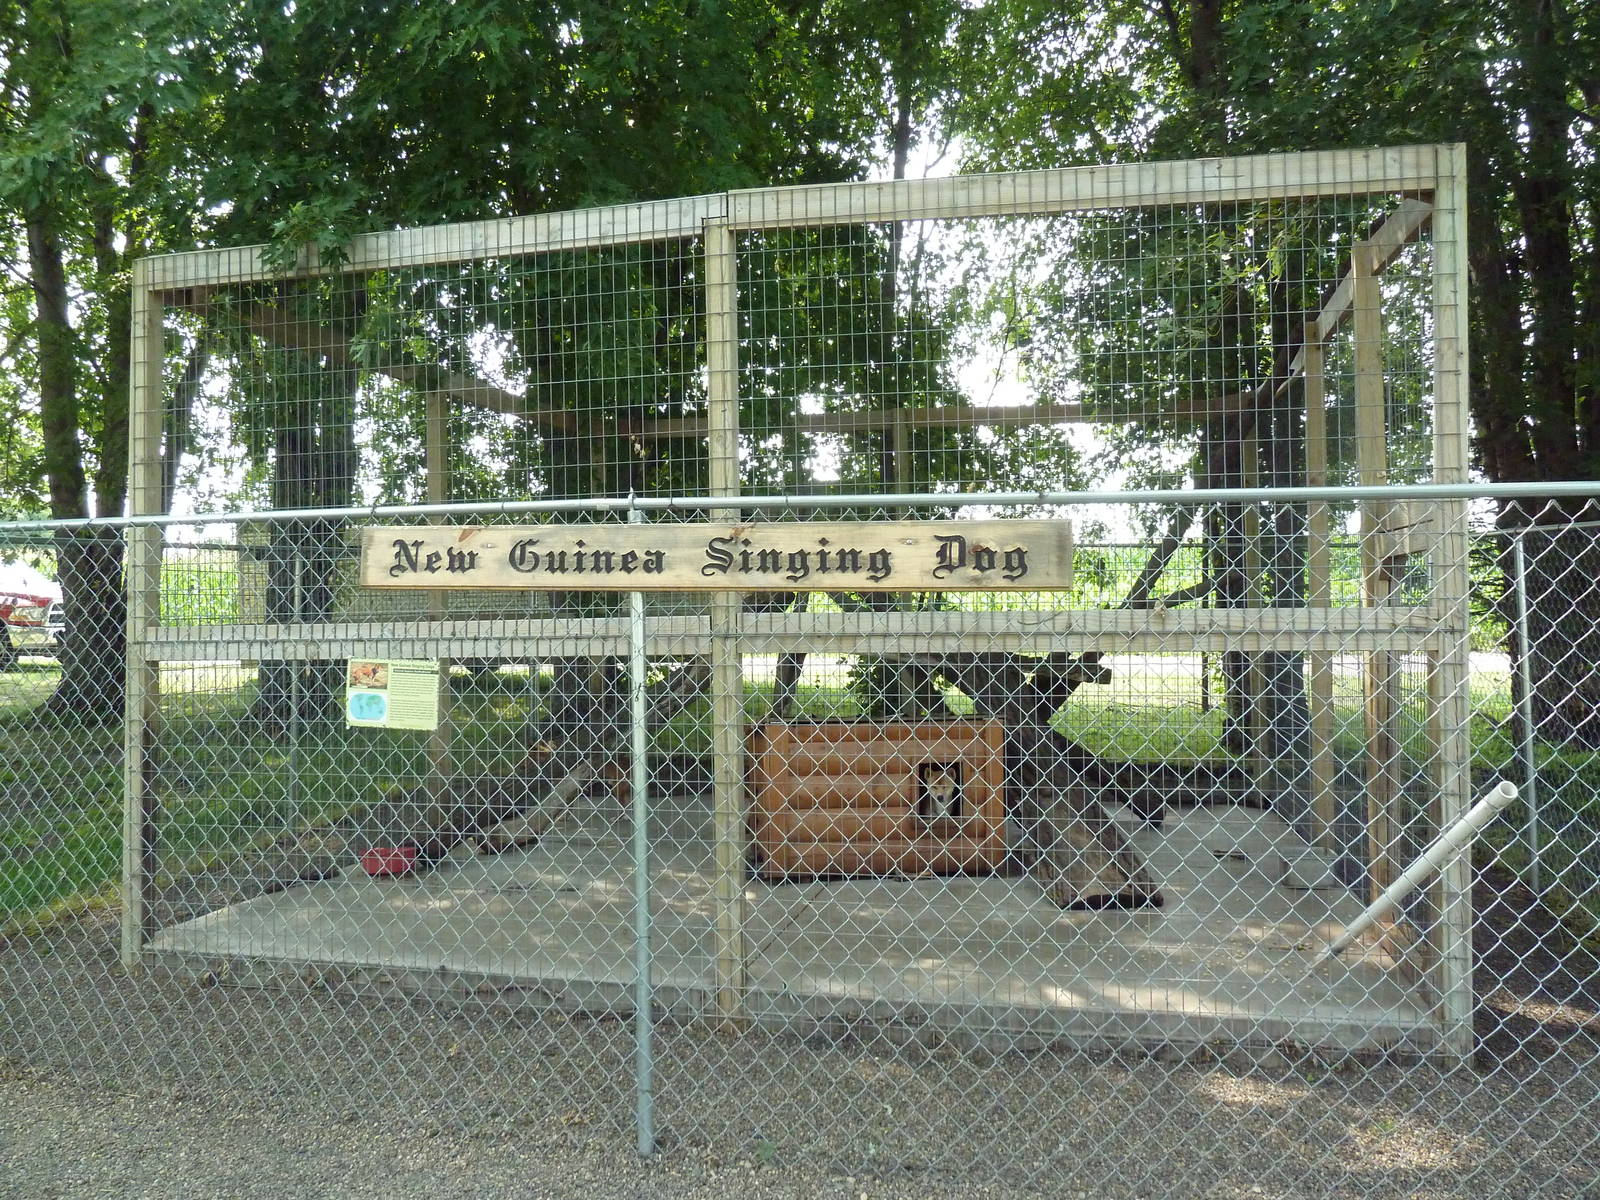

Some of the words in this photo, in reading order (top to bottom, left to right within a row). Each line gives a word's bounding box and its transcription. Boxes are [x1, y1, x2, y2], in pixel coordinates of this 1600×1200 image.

[389, 539, 478, 577] New
[509, 538, 665, 575] Guinea
[701, 536, 892, 582] Singing
[933, 535, 1028, 581] Dog
